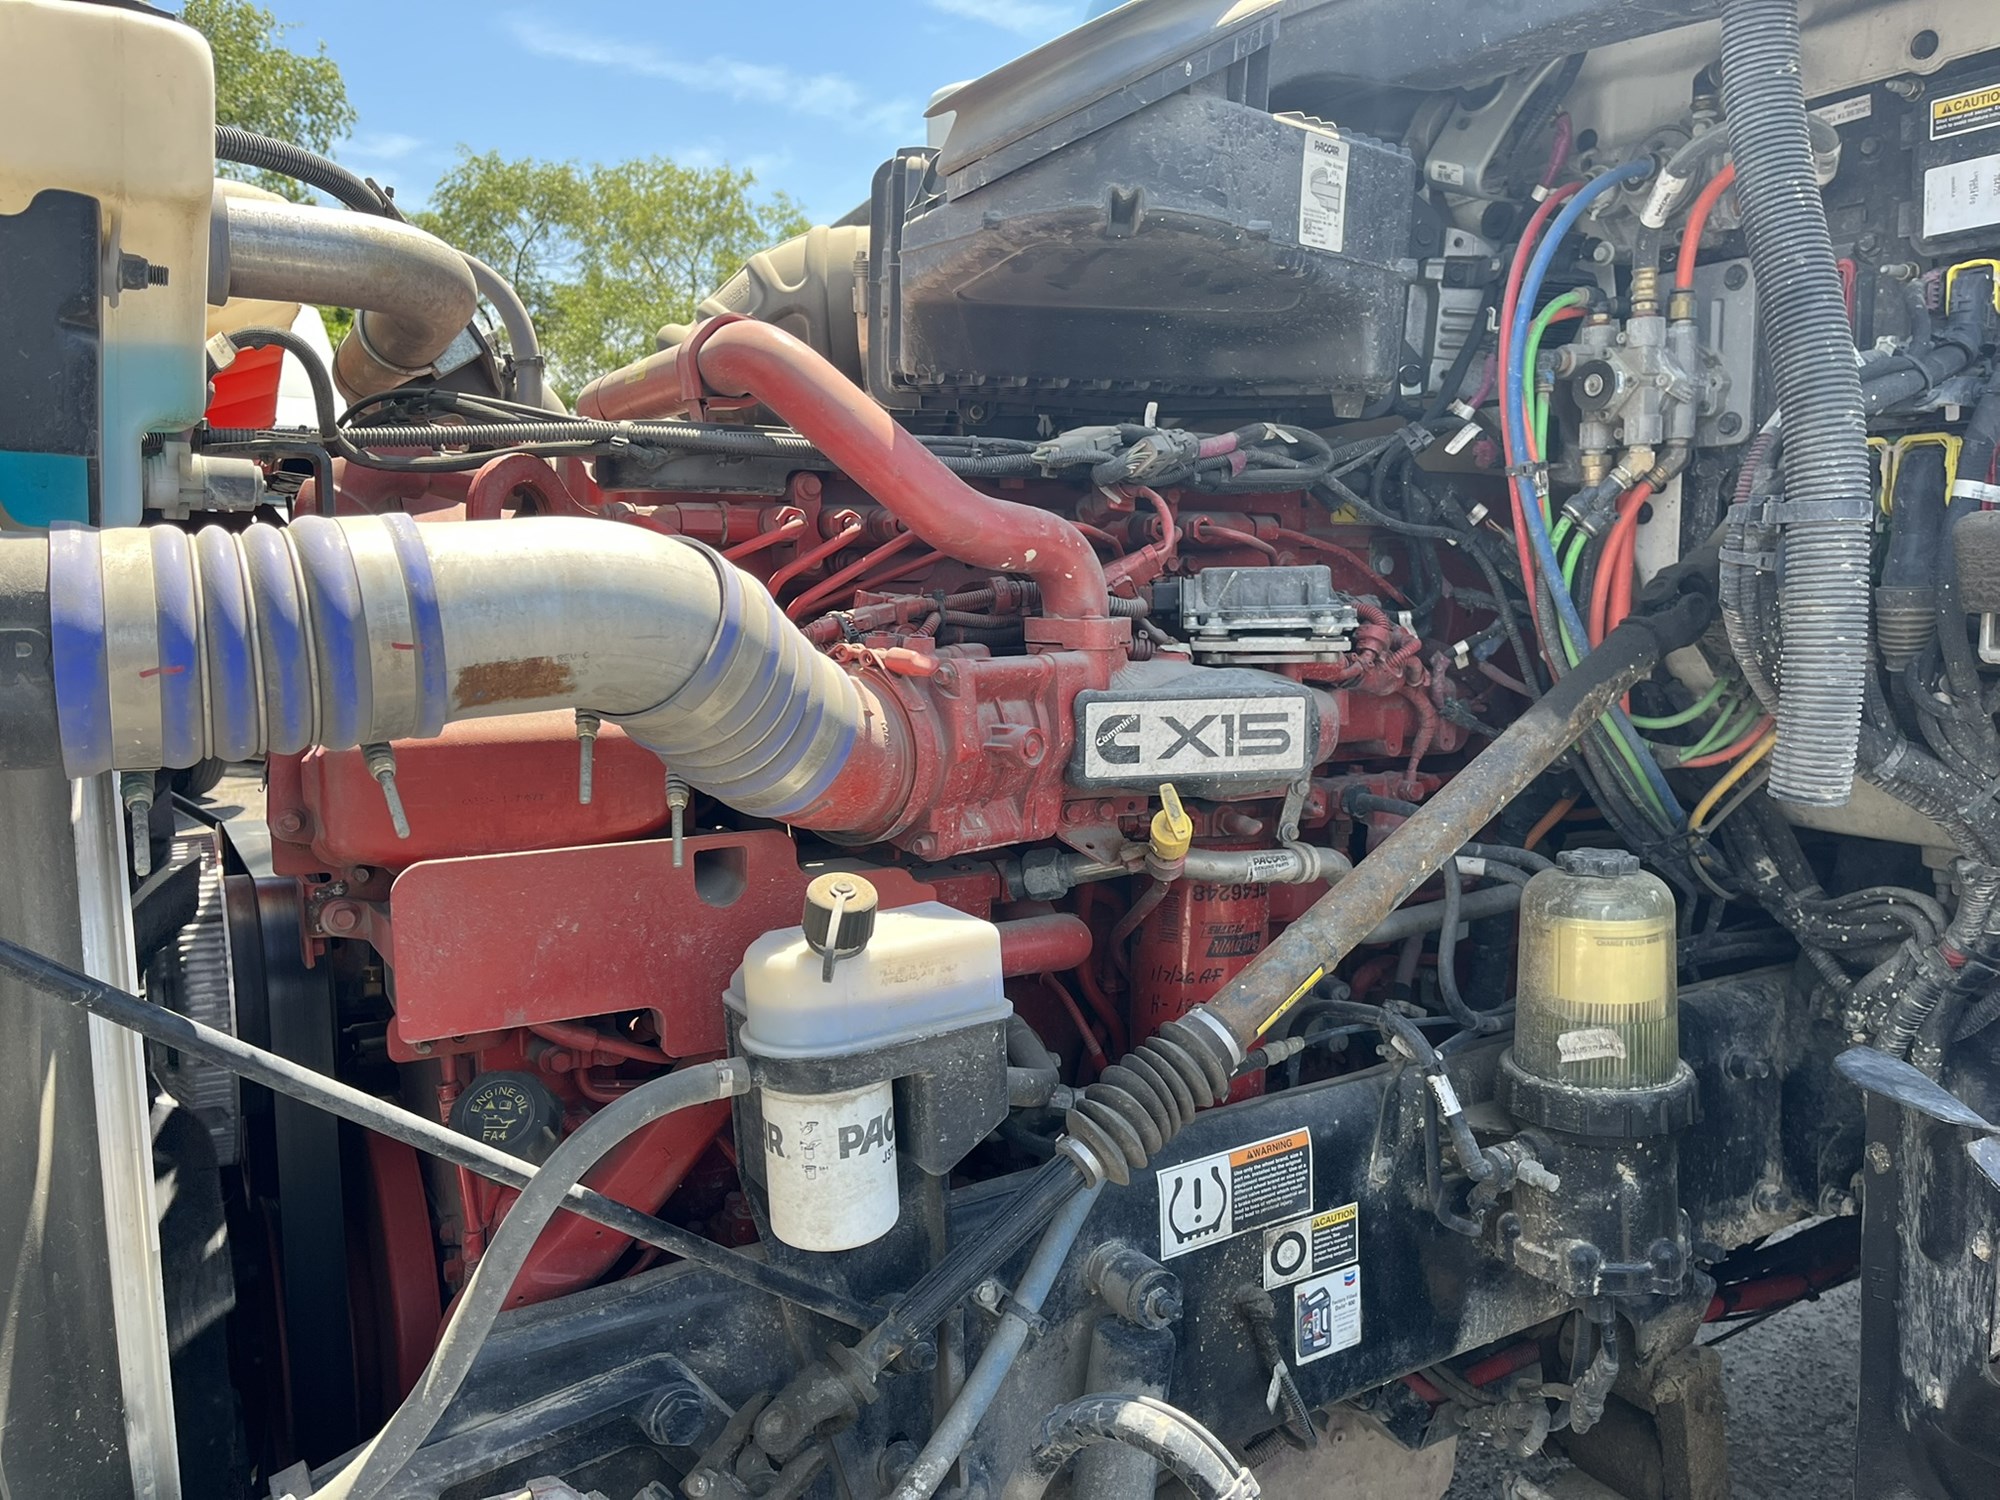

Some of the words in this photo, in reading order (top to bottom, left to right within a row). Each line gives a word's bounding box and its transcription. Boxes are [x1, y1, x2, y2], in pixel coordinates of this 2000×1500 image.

[1954, 91, 2000, 111] CAUTIO
[1314, 140, 1340, 156] PACCAR
[1096, 713, 1138, 747] Cummins
[1156, 712, 1291, 760] X15
[470, 1086, 517, 1113] ENGINE
[514, 1094, 528, 1115] OIL
[483, 1131, 507, 1141] FA4
[1253, 1139, 1292, 1157] WARNING
[1234, 1178, 1257, 1189] equipment
[1234, 1186, 1252, 1195] different
[1251, 1192, 1276, 1202] component
[1261, 1203, 1279, 1213] personal
[1320, 1208, 1355, 1225] CAUTION
